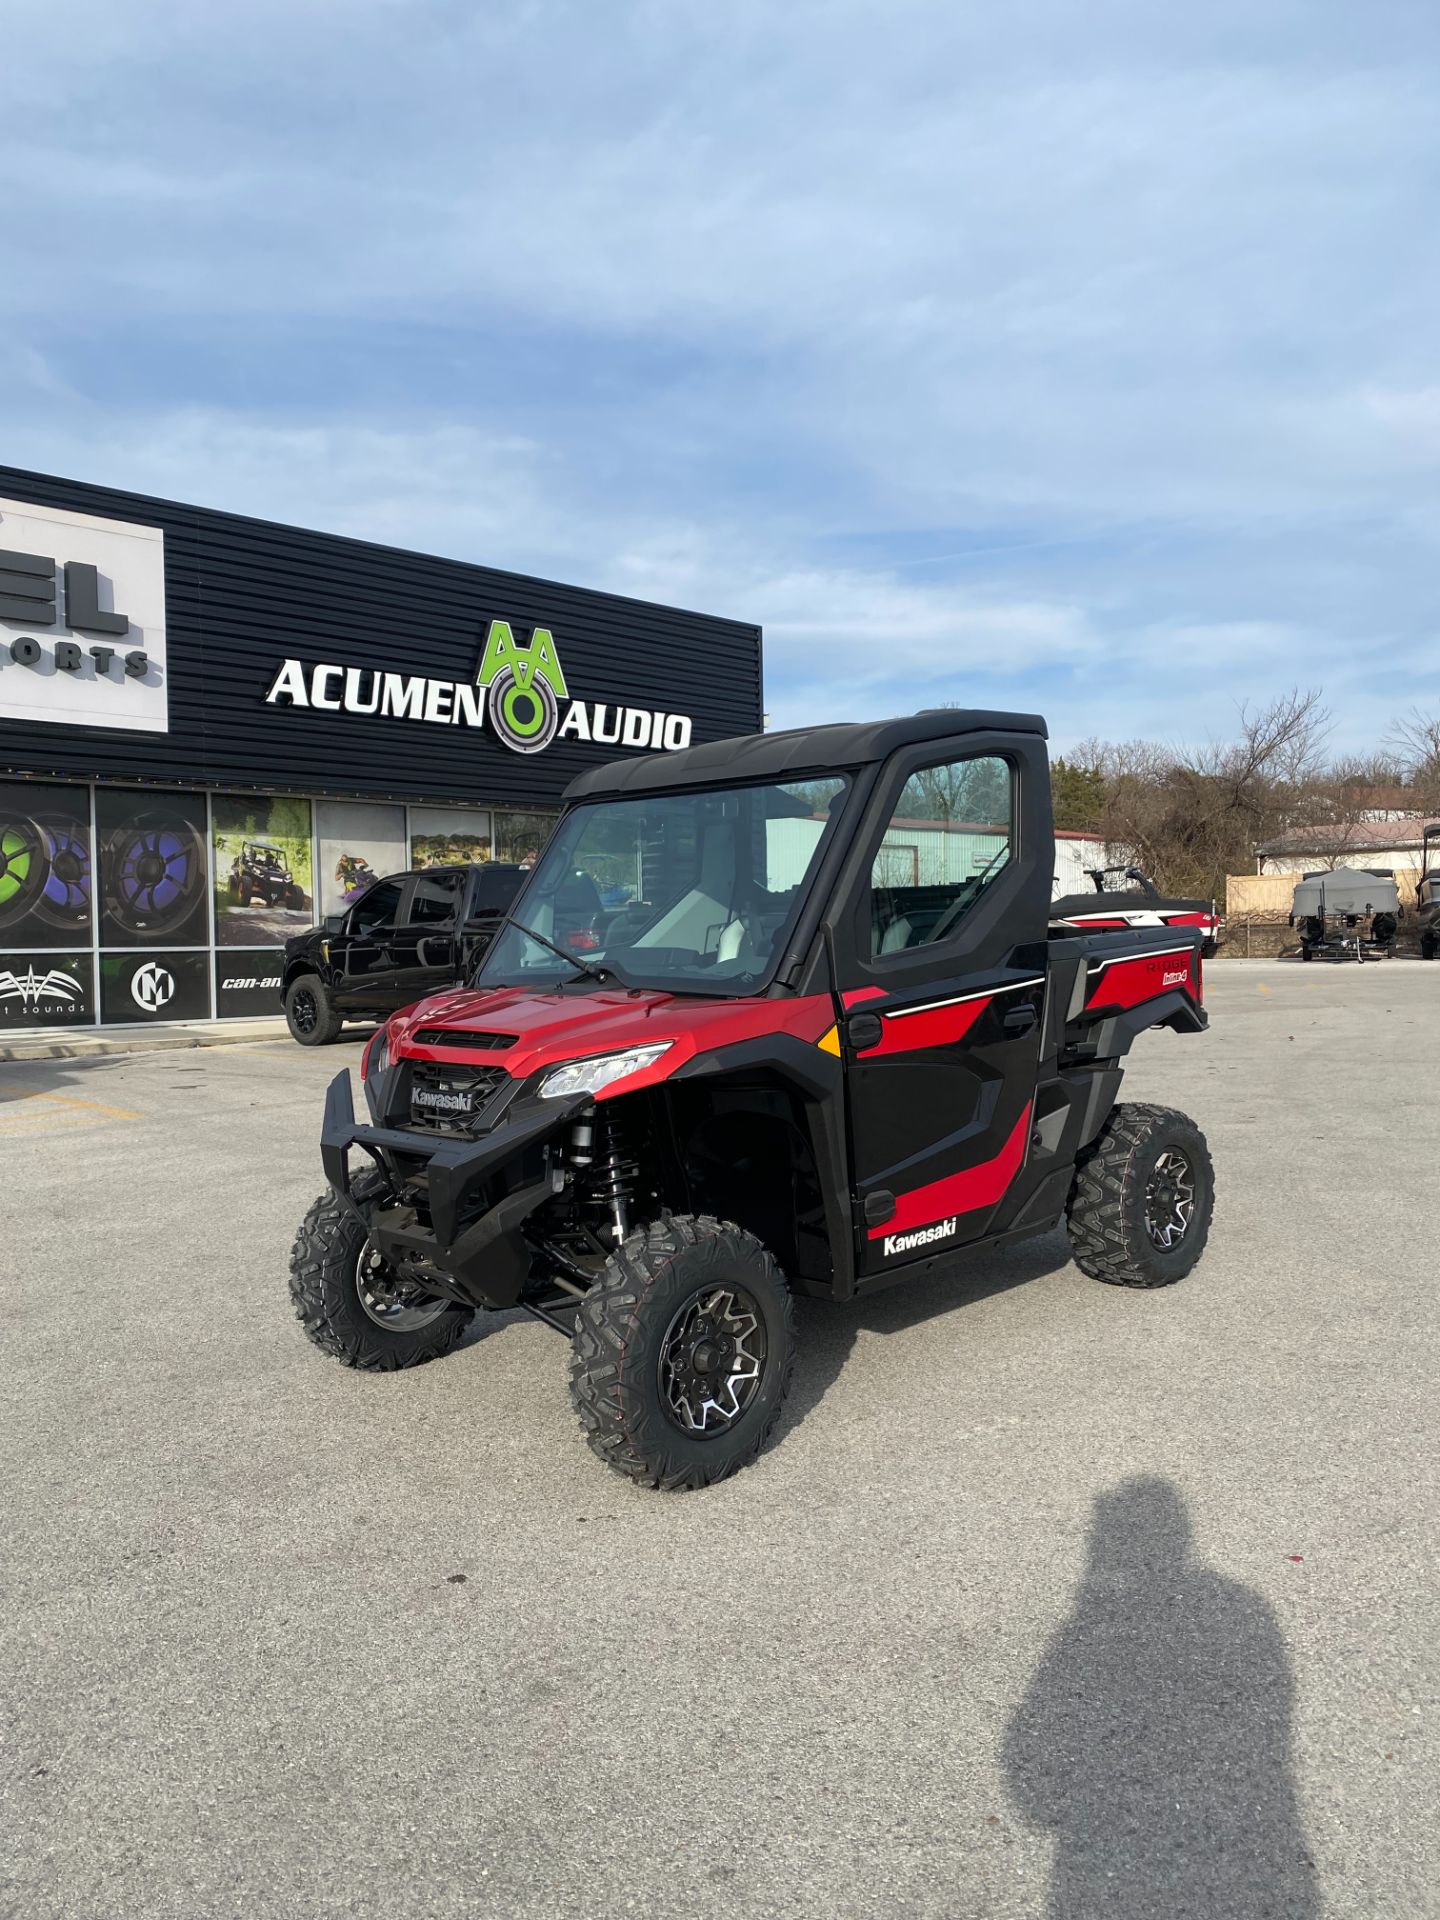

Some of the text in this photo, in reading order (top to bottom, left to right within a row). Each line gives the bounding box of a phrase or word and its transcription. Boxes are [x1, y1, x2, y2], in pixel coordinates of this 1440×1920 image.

[265, 659, 692, 750] ACUMEN AUDIO
[1147, 958, 1186, 973] RIDGE
[22, 1004, 85, 1014] sounds
[411, 1087, 472, 1111] Kawasaki
[883, 1217, 957, 1256] Kawasaki
